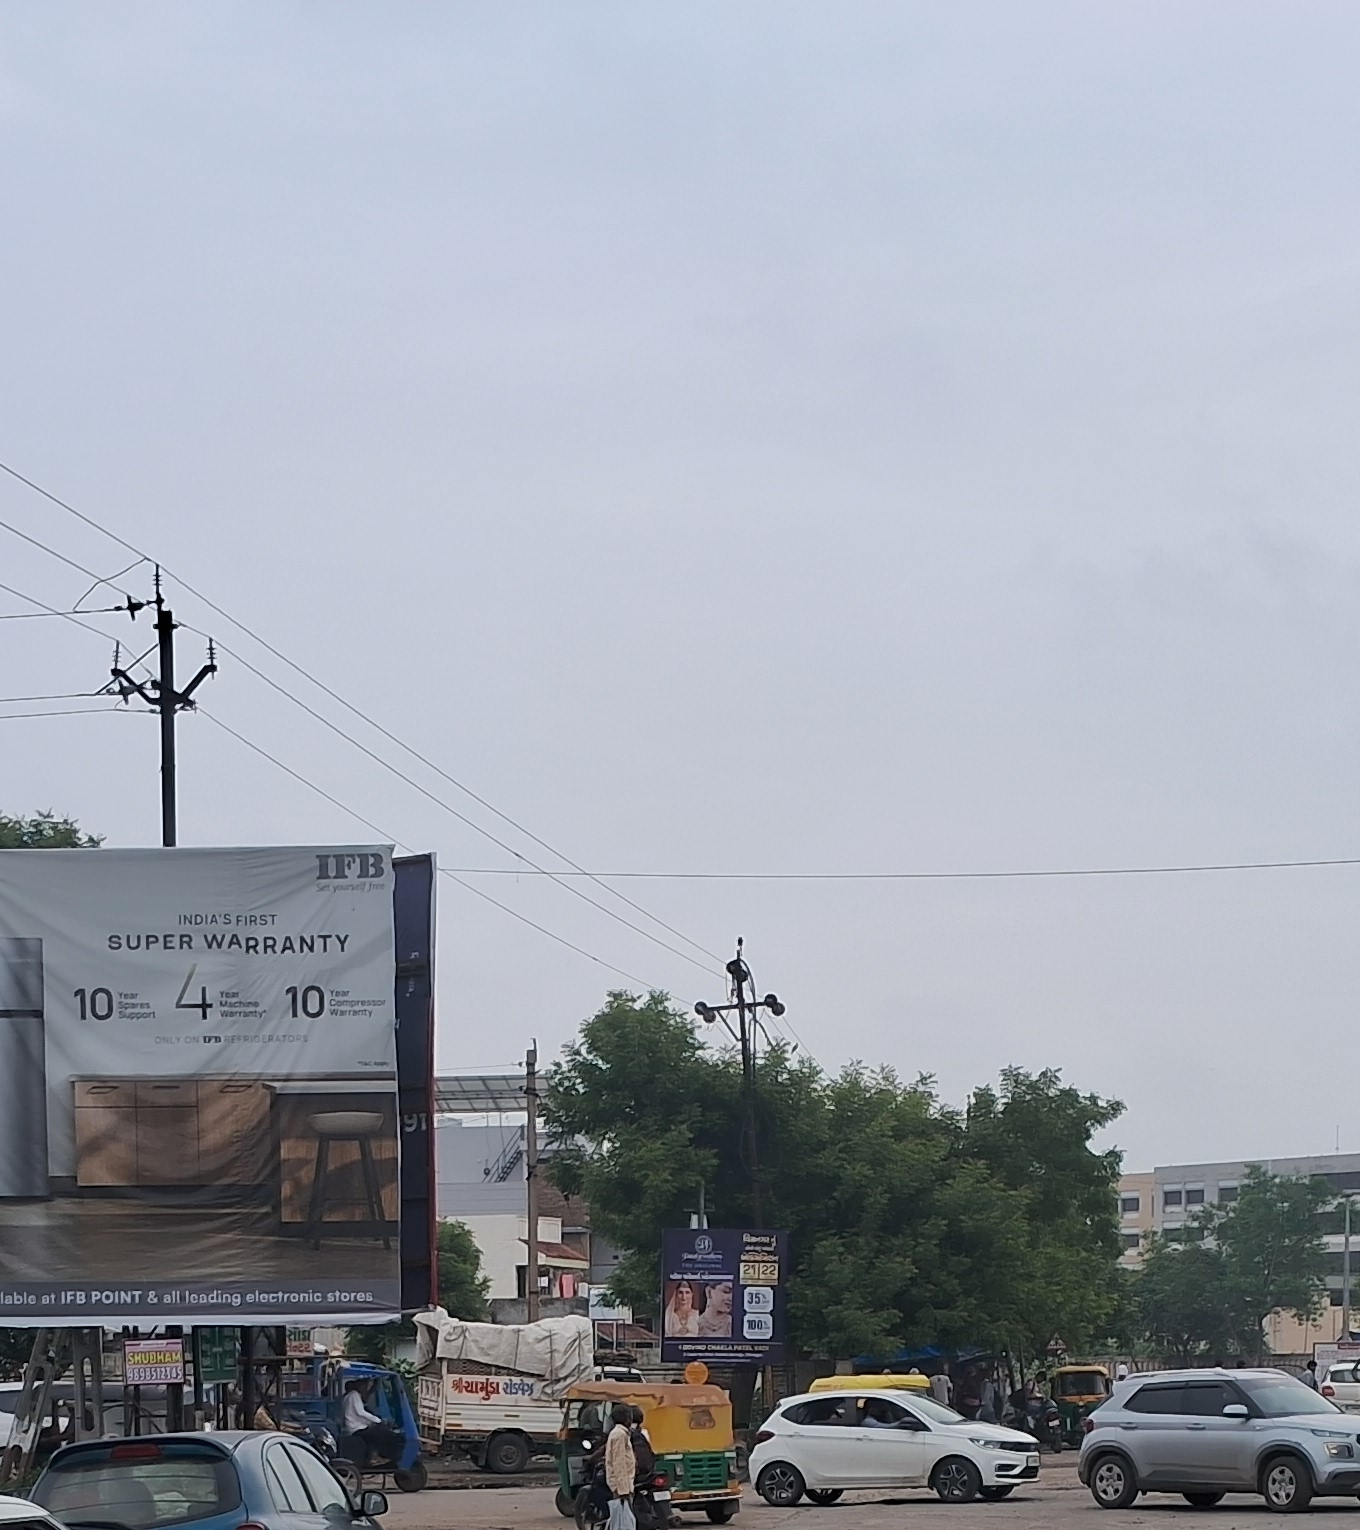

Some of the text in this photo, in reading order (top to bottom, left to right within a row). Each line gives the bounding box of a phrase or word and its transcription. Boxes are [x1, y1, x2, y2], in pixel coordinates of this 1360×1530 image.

[316, 853, 385, 880] IFB
[177, 913, 278, 927] INDIA'S FIRST
[107, 932, 350, 955] SUPER WARRANTY
[117, 991, 139, 999] Year
[175, 963, 214, 1021] 4
[219, 990, 240, 998] Year
[329, 988, 350, 998] Year
[73, 987, 114, 1021] 10
[118, 1001, 151, 1011] Spares
[285, 985, 325, 1019] 10
[329, 999, 386, 1008] Compressor
[118, 1011, 156, 1020] Support
[329, 1008, 373, 1018] Warranty
[154, 1036, 181, 1044] ONLY
[224, 1034, 309, 1044] REFRIGERATORS
[743, 1263, 756, 1275] 21
[761, 1264, 777, 1276] 22
[41, 1291, 56, 1305] at
[60, 1290, 87, 1305] IFB
[91, 1290, 143, 1304] POINT
[146, 1290, 159, 1304] &
[163, 1290, 181, 1304] all
[185, 1290, 242, 1307] leading
[245, 1289, 323, 1303] electronic
[326, 1290, 374, 1303] stores
